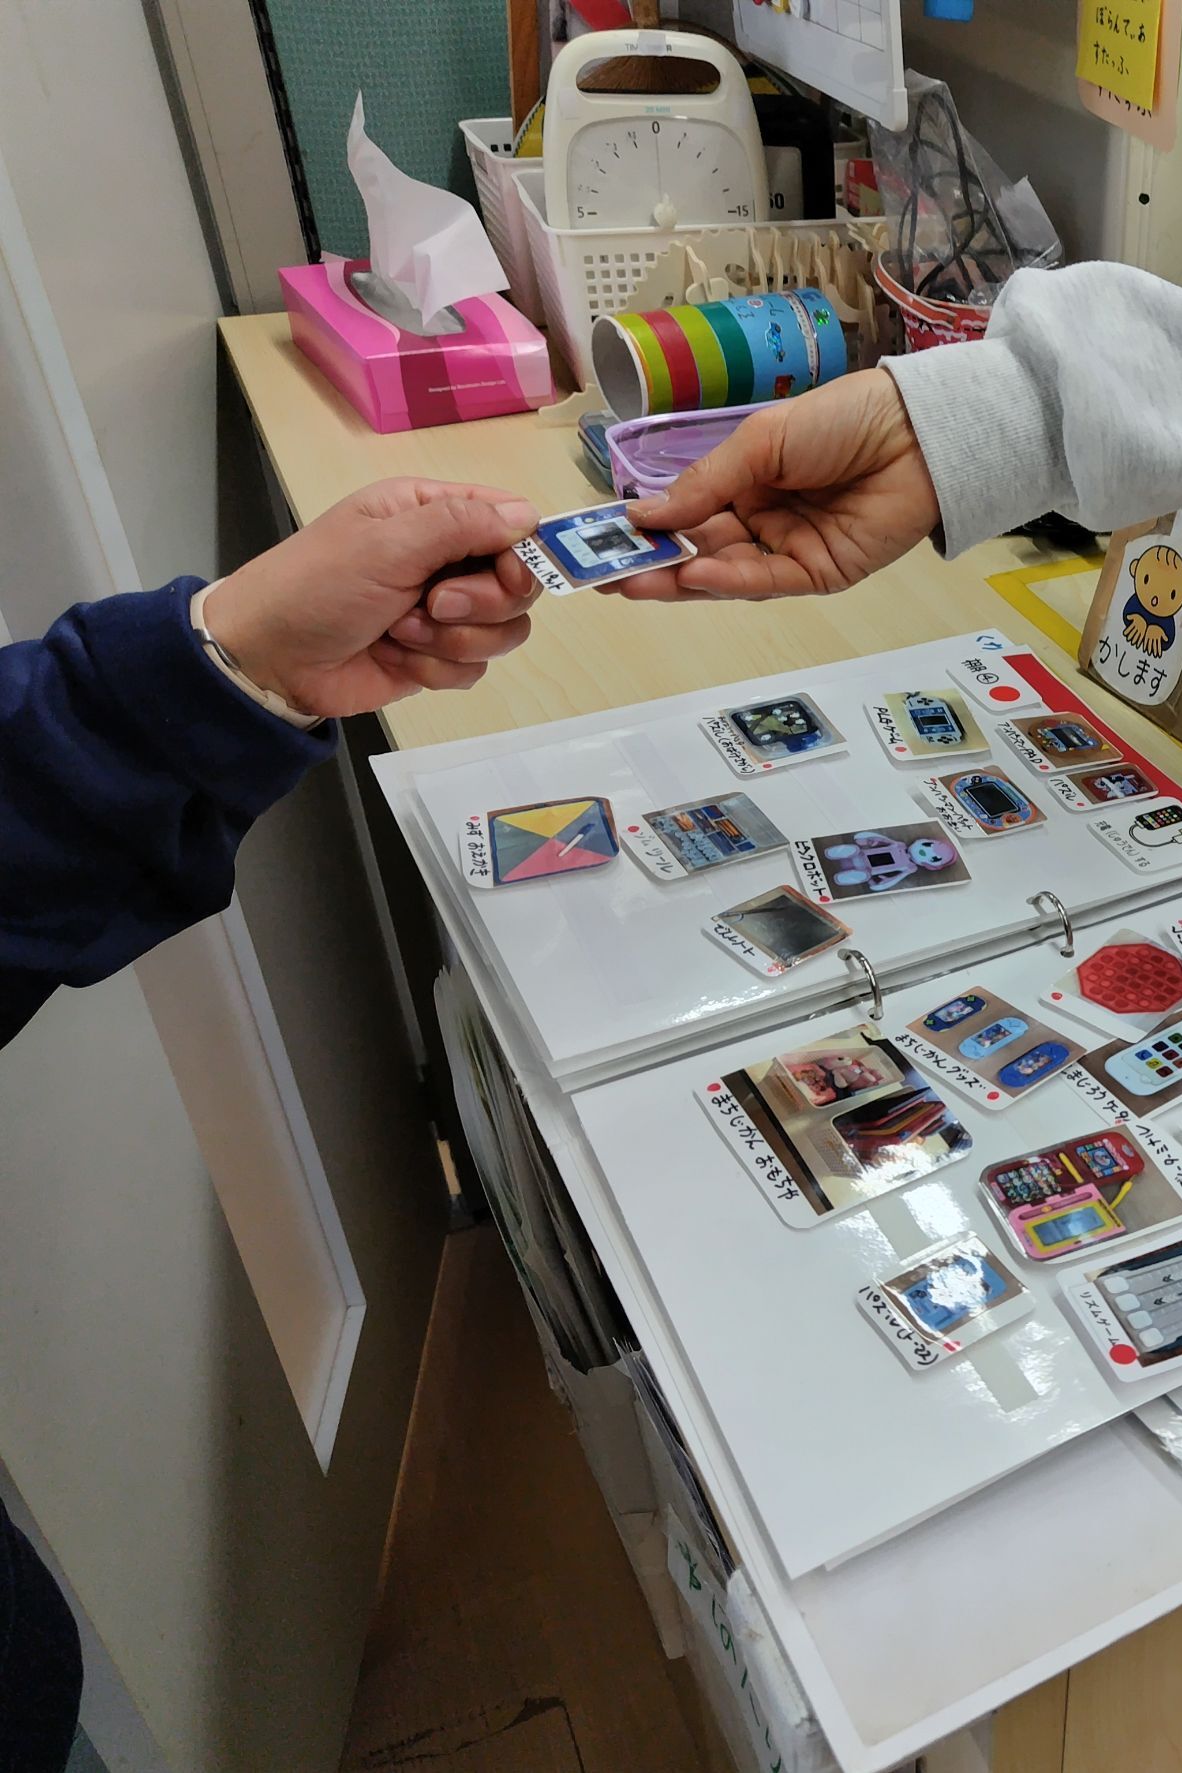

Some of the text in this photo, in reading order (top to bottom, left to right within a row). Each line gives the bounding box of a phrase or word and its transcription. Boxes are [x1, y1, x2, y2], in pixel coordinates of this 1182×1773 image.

[1093, 40, 1130, 75] すたっふ
[651, 121, 661, 134] 0
[577, 206, 585, 218] 5
[1098, 636, 1168, 698] かします
[711, 1094, 800, 1200] まちじかん おもちゃ
